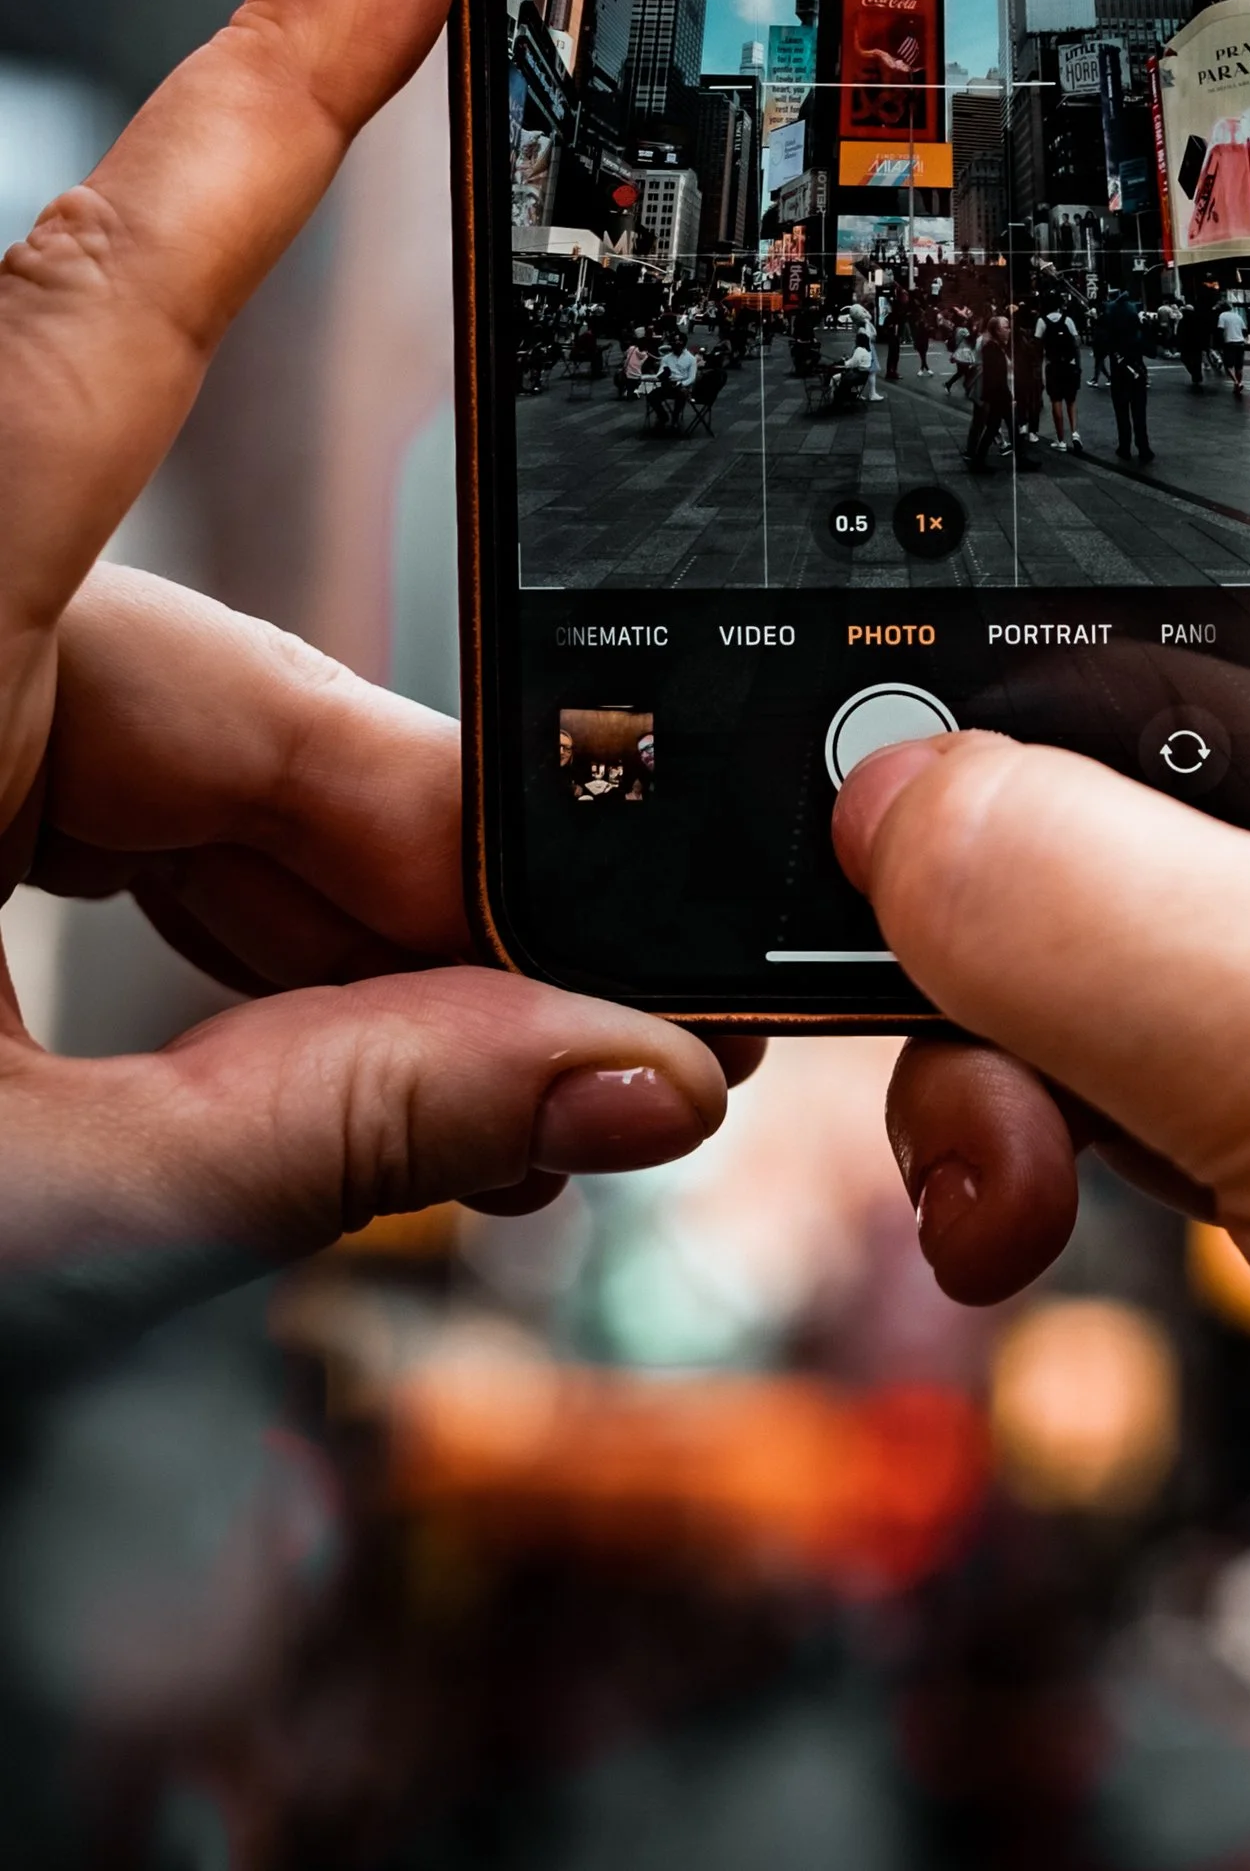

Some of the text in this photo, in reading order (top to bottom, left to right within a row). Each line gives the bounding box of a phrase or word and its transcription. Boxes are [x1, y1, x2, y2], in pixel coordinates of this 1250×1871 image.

[1065, 43, 1096, 62] LITTLE
[768, 116, 784, 125] your
[775, 105, 788, 113] rest
[789, 265, 802, 291] tkts
[1086, 274, 1099, 299] tkts
[835, 514, 868, 533] 0.5
[555, 625, 669, 648] CINEMATIC
[719, 625, 796, 648] VIDEO
[847, 624, 937, 647] PHOTO
[988, 623, 1113, 646] PORTRAIT
[1160, 623, 1218, 646] PANO
